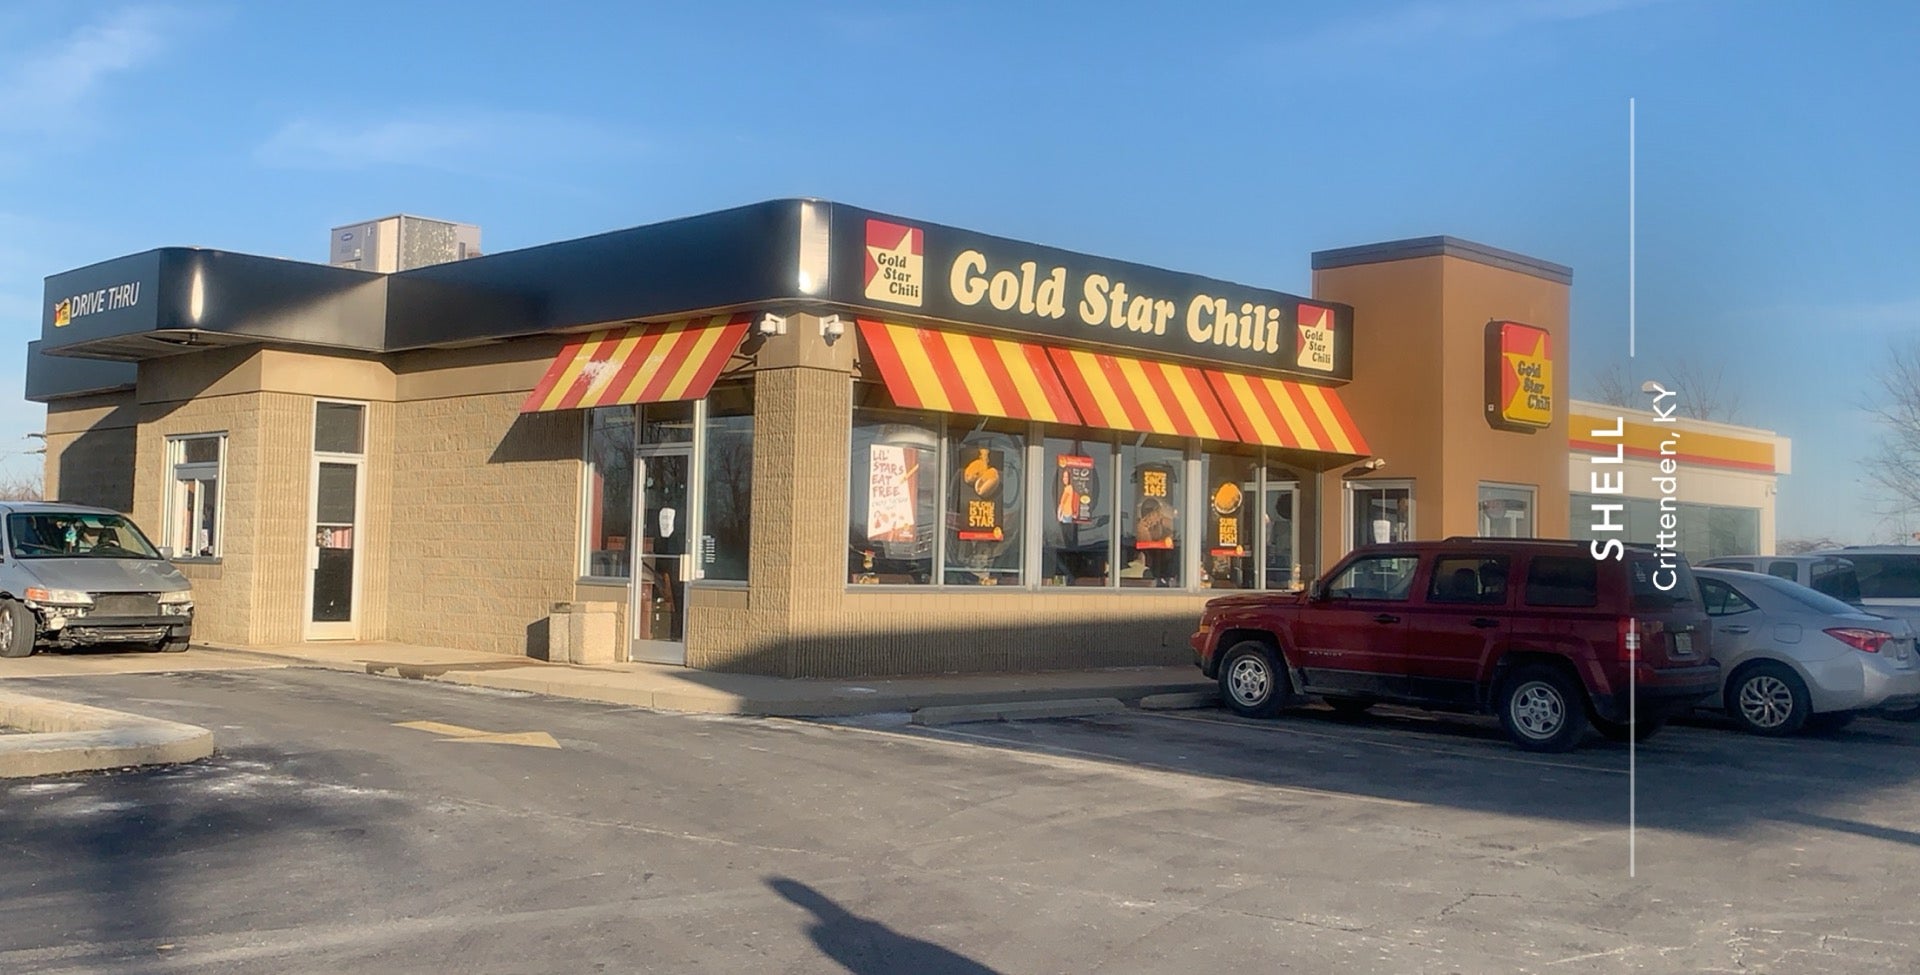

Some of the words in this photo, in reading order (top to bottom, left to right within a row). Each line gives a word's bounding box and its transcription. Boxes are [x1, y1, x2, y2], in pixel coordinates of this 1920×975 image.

[877, 252, 907, 269] Gold
[883, 267, 912, 283] Star
[889, 281, 919, 298] Chili
[71, 289, 106, 319] DRIVE
[108, 281, 140, 310] THRU
[950, 250, 1067, 319] Gold
[1079, 274, 1175, 336] Star
[1186, 294, 1281, 354] Chili
[1305, 329, 1324, 341] Gold
[1309, 341, 1326, 352] Star
[1312, 351, 1331, 364] Chili
[1517, 360, 1541, 378] Gold
[1523, 377, 1544, 394] Star
[1527, 394, 1551, 411] Chili
[872, 449, 890, 461] LIL'
[873, 461, 905, 476] STARS
[871, 474, 893, 486] EAT
[1144, 475, 1167, 485] SINCE
[871, 486, 900, 498] FREE
[1144, 485, 1167, 497] 1965
[969, 507, 978, 516] IS
[978, 507, 995, 516] THE
[969, 516, 995, 528] STAR
[1219, 533, 1238, 544] FISH
